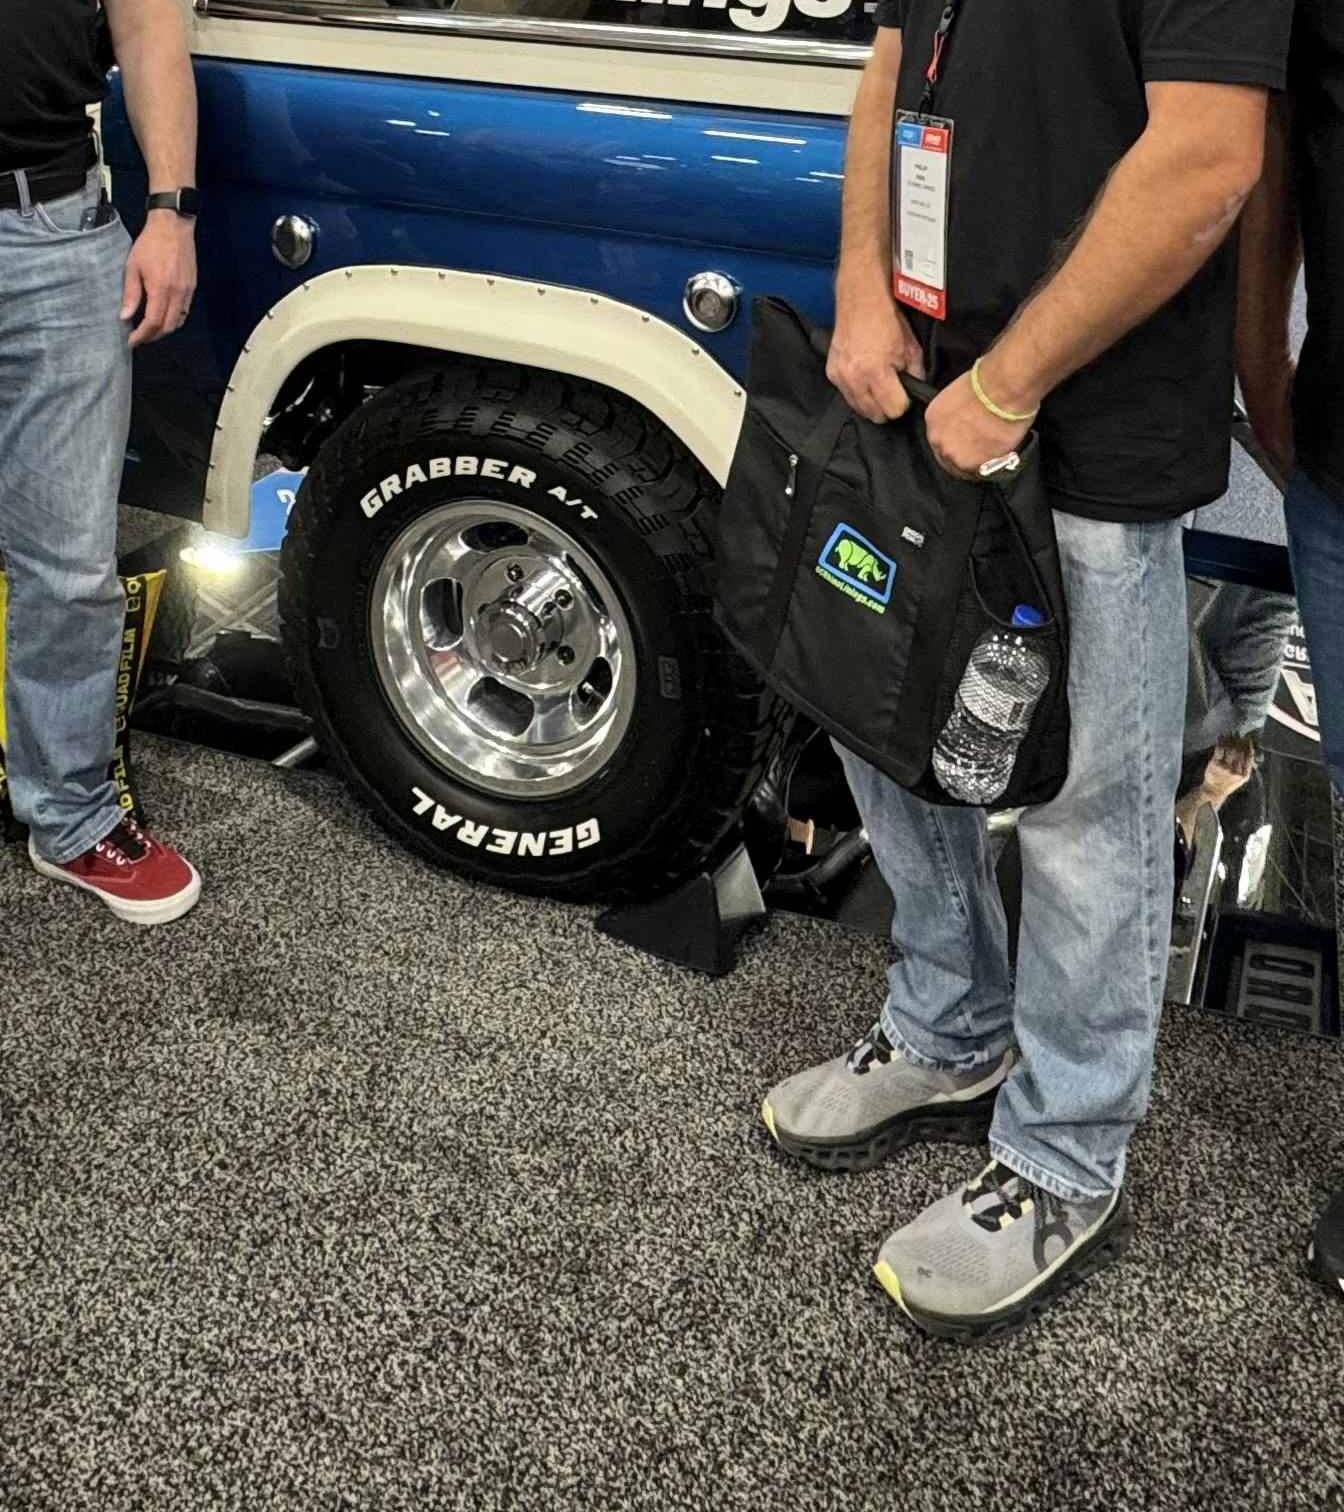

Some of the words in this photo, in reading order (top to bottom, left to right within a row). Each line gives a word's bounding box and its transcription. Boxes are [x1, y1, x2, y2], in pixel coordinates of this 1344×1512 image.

[359, 455, 537, 519] GRABBER
[547, 485, 599, 520] A/T
[411, 785, 601, 857] GENERAL
